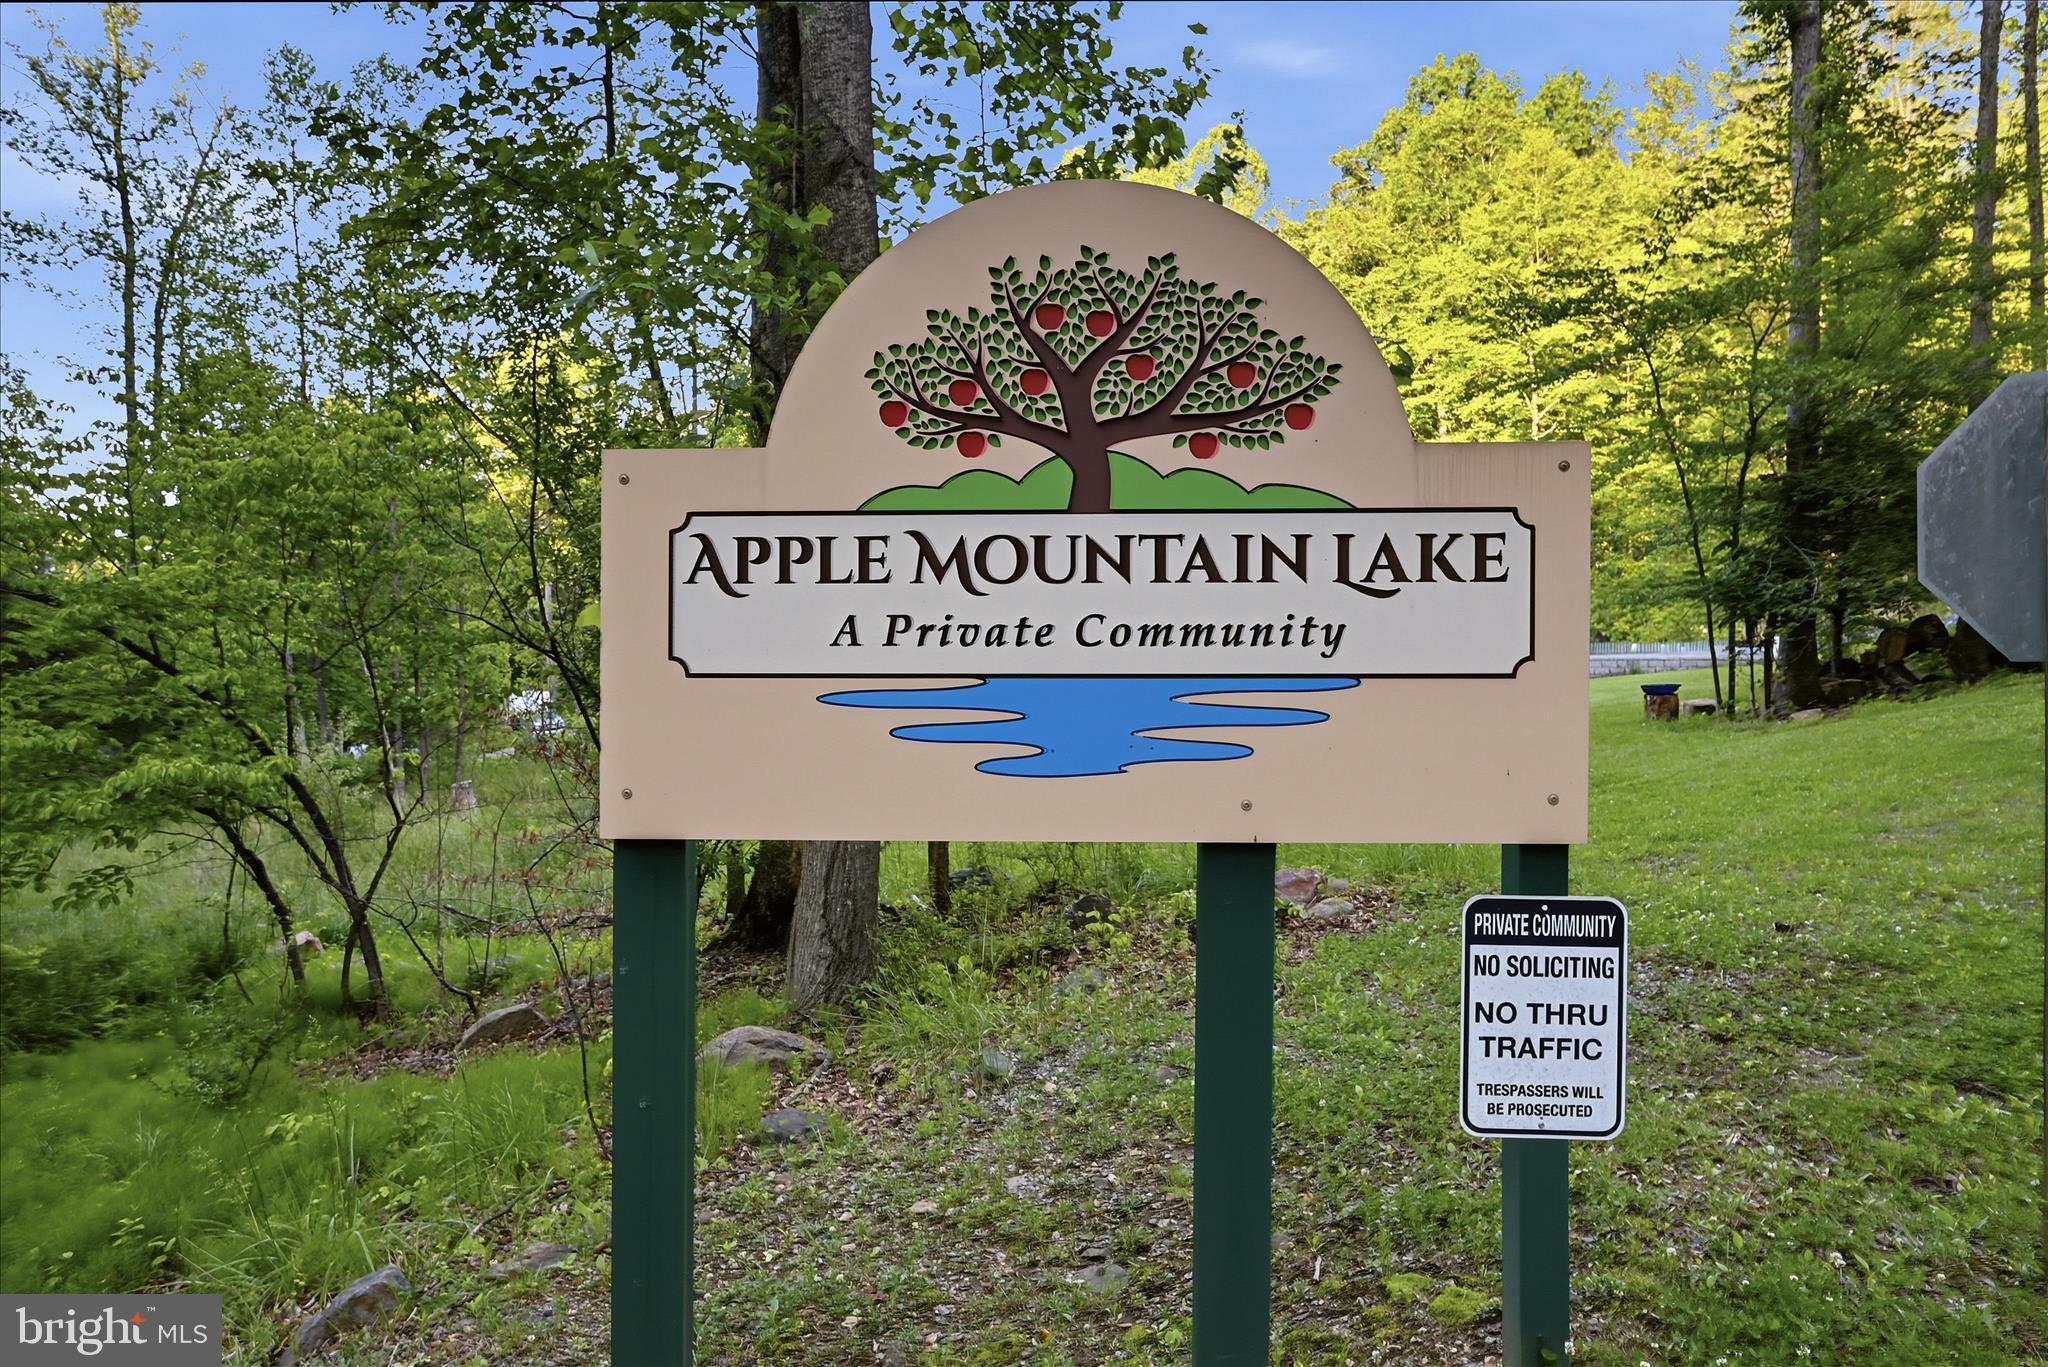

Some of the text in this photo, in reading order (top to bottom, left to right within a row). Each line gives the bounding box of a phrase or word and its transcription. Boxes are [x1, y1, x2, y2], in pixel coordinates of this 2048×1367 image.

[683, 530, 1510, 598] APPLE MOUNTAIN LAKE
[829, 613, 1347, 658] A Private Community
[1474, 913, 1617, 938] PRIVATE COMMUNITY
[1474, 955, 1615, 979] NO SOLICITING
[1475, 1002, 1608, 1026] NO THRU
[1478, 1036, 1603, 1060] TRAFFIC
[1477, 1083, 1604, 1099] TRESPASSERS WILL
[1487, 1103, 1593, 1118] BE PROSECUTED
